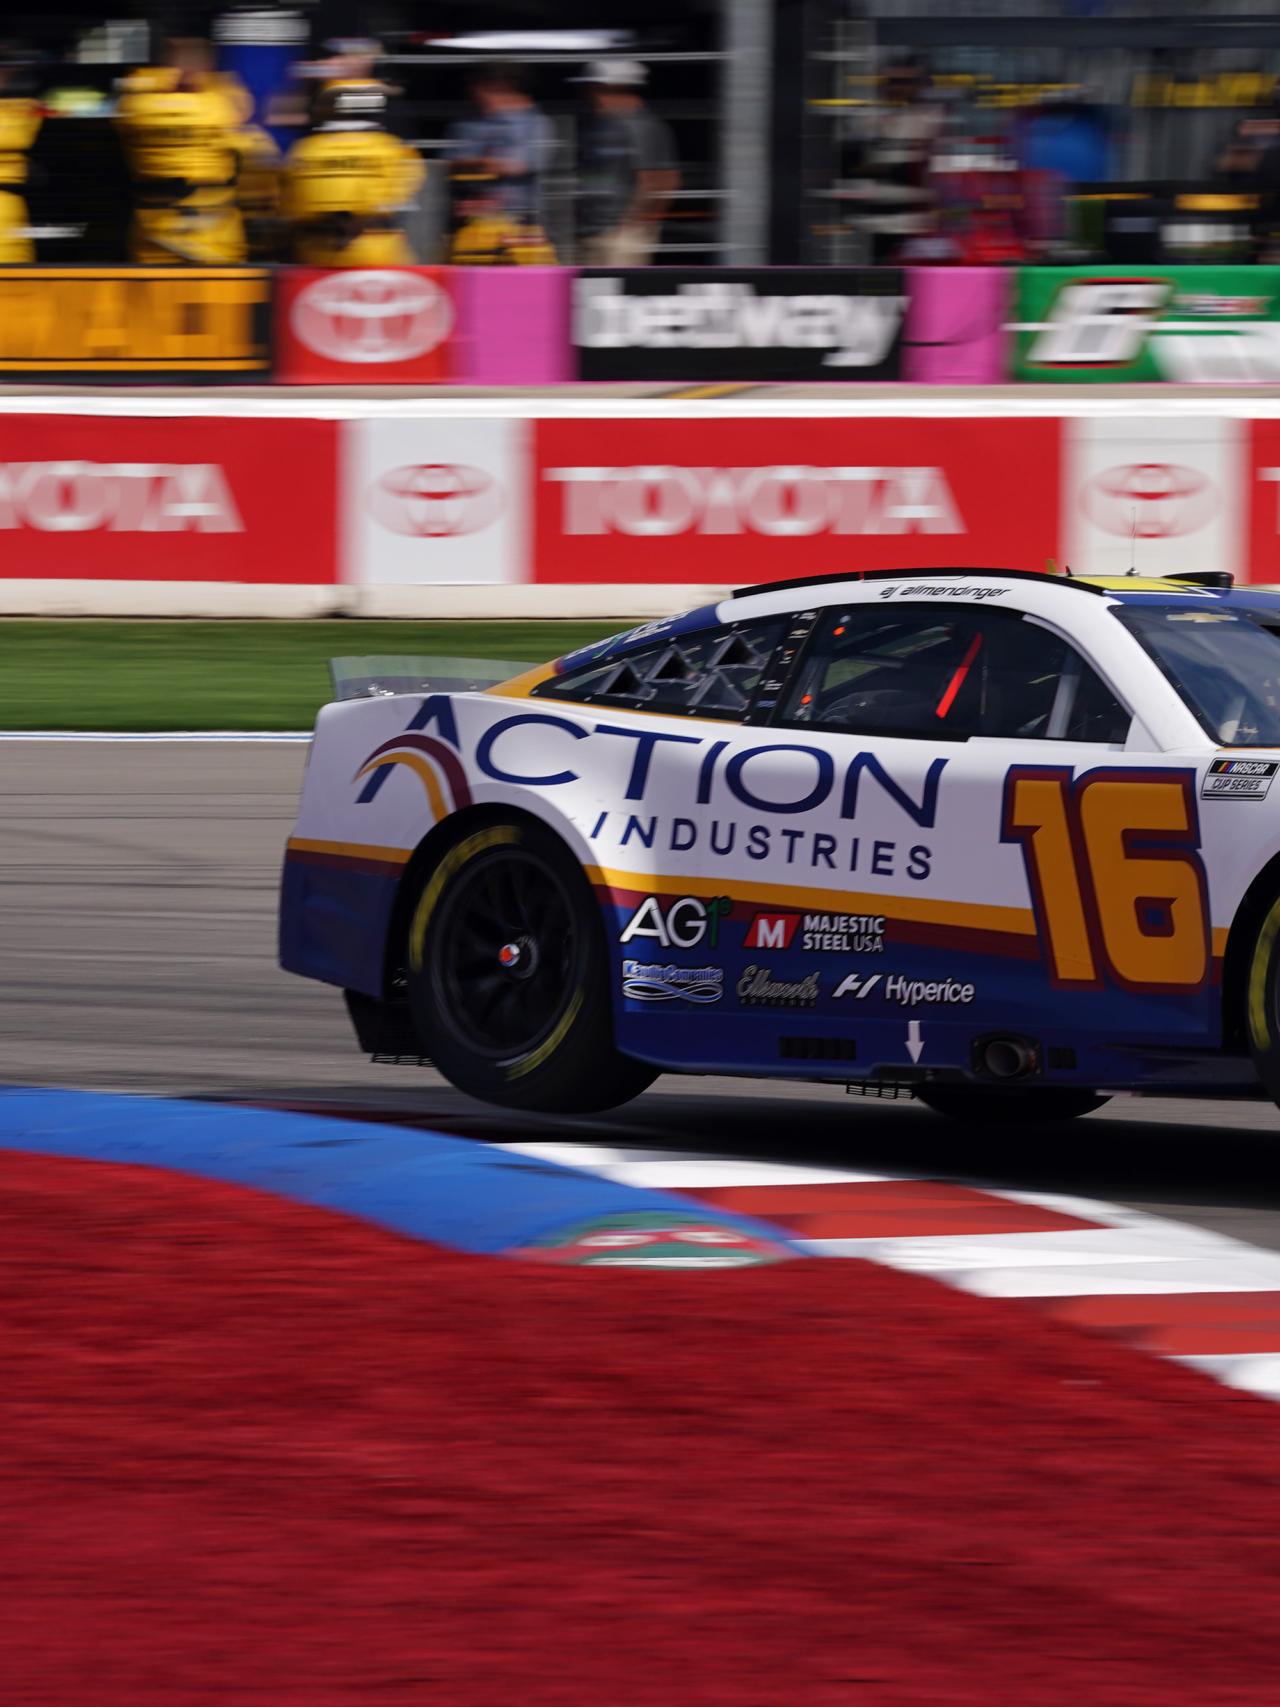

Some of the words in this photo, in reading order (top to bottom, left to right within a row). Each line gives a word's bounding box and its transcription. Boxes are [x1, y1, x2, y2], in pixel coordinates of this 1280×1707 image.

[543, 466, 966, 537] TOYOTA
[354, 695, 949, 830] ACTION
[1229, 762, 1269, 775] NASCAR
[1231, 778, 1261, 790] SERIES
[588, 811, 934, 882] INDUSTRIES
[1000, 765, 1210, 992] 16
[756, 918, 786, 949] M
[803, 914, 885, 934] MAJESTIC
[803, 932, 851, 951] STEEL
[852, 935, 884, 952] USA
[886, 974, 975, 1006] Hyperice
